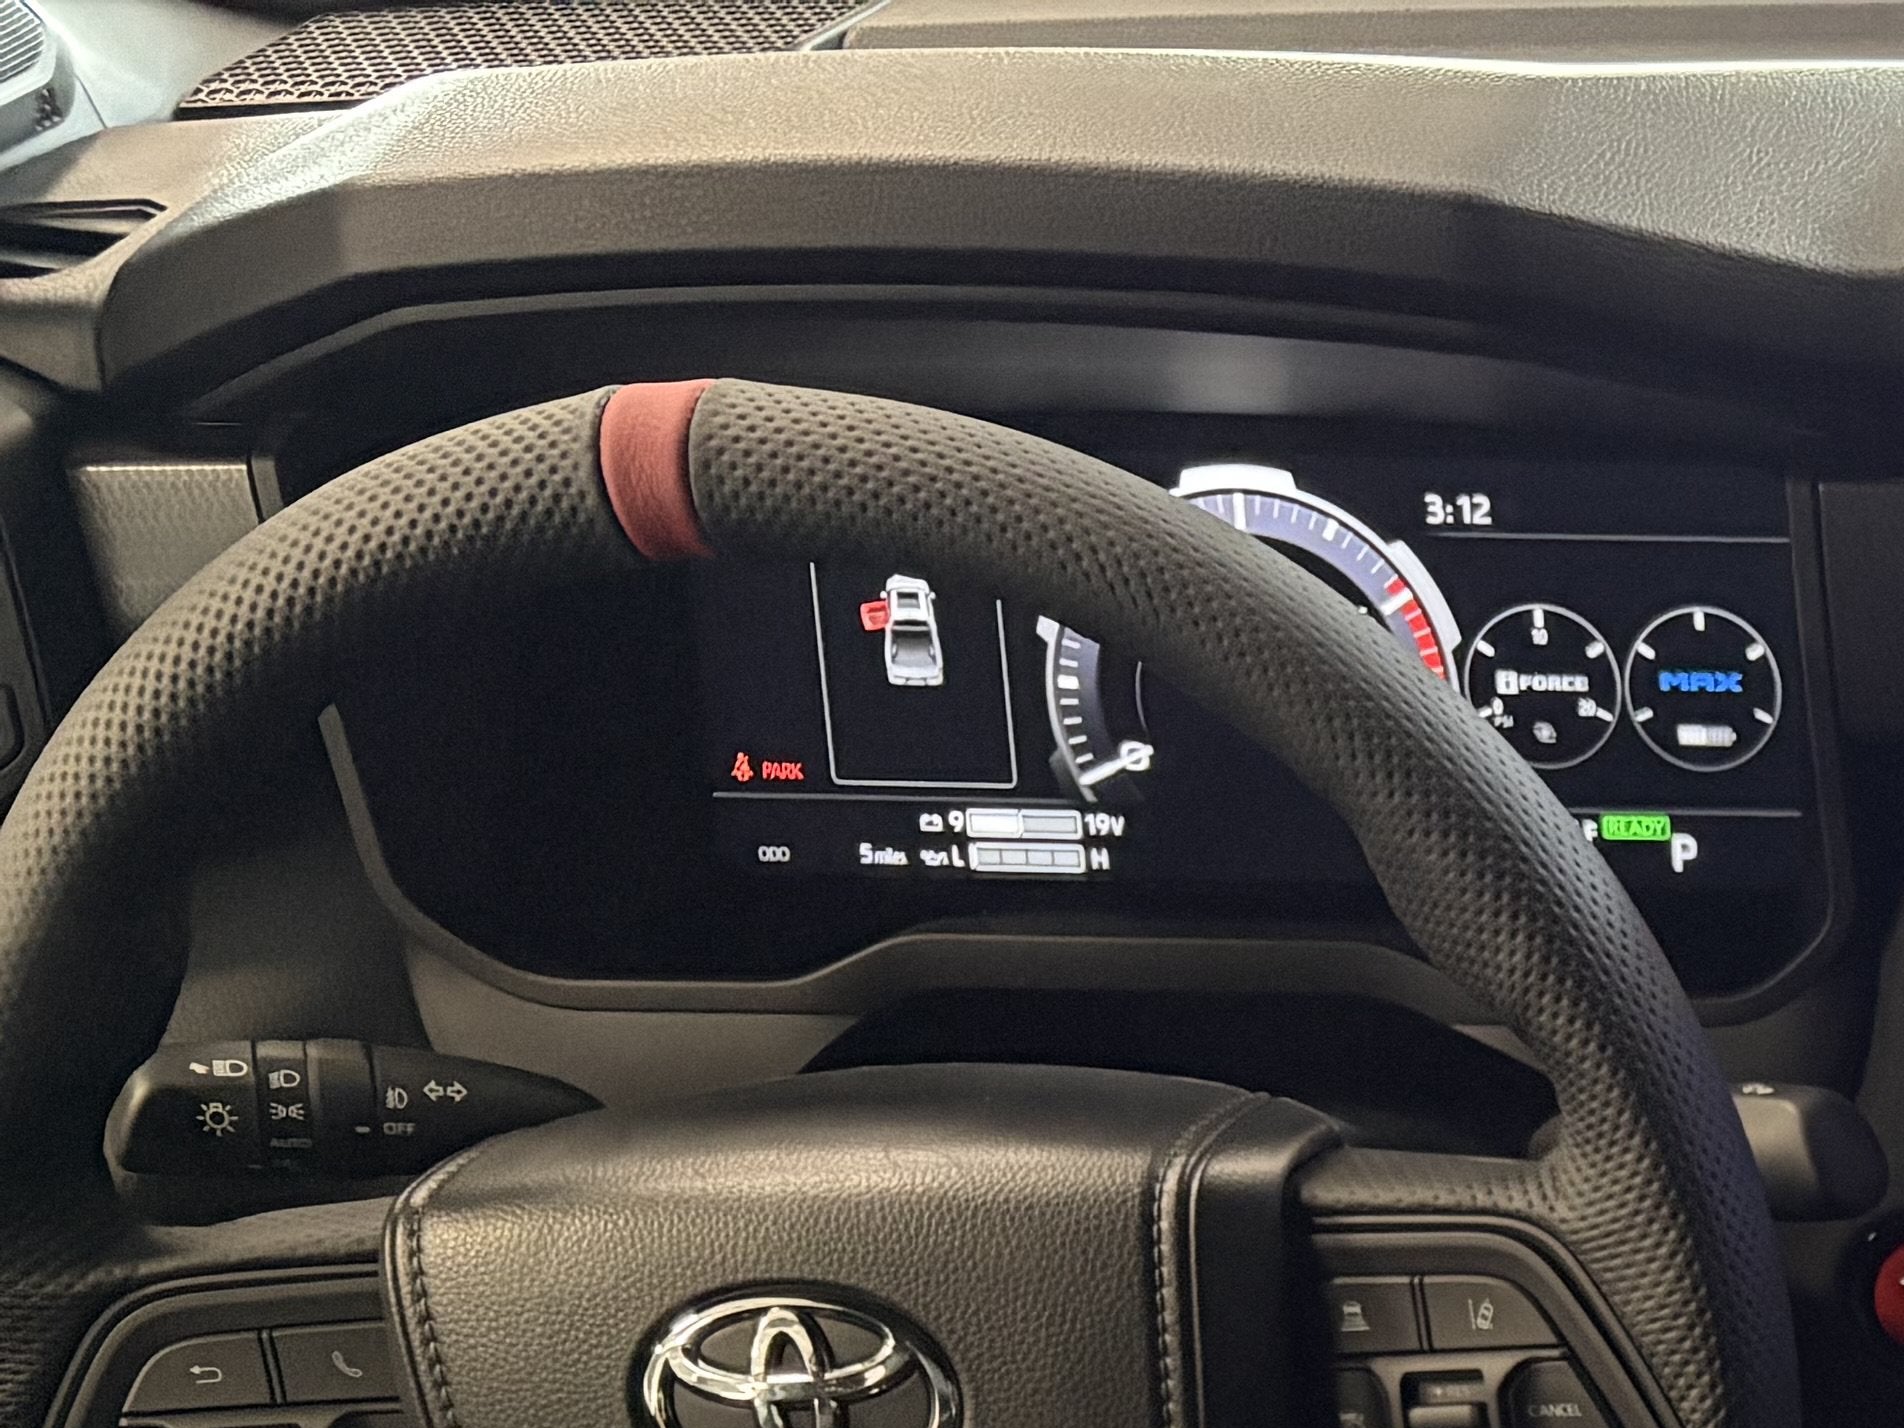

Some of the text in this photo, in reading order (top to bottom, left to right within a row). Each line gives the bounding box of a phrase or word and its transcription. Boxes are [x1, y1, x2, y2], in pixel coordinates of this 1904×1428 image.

[1423, 491, 1493, 526] 3:12
[1658, 669, 1744, 694] MAX
[762, 760, 805, 781] PARK
[948, 810, 965, 832] 9
[1606, 819, 1667, 838] READY
[1090, 849, 1111, 871] H
[1670, 832, 1698, 873] P
[383, 1122, 416, 1136] OFF
